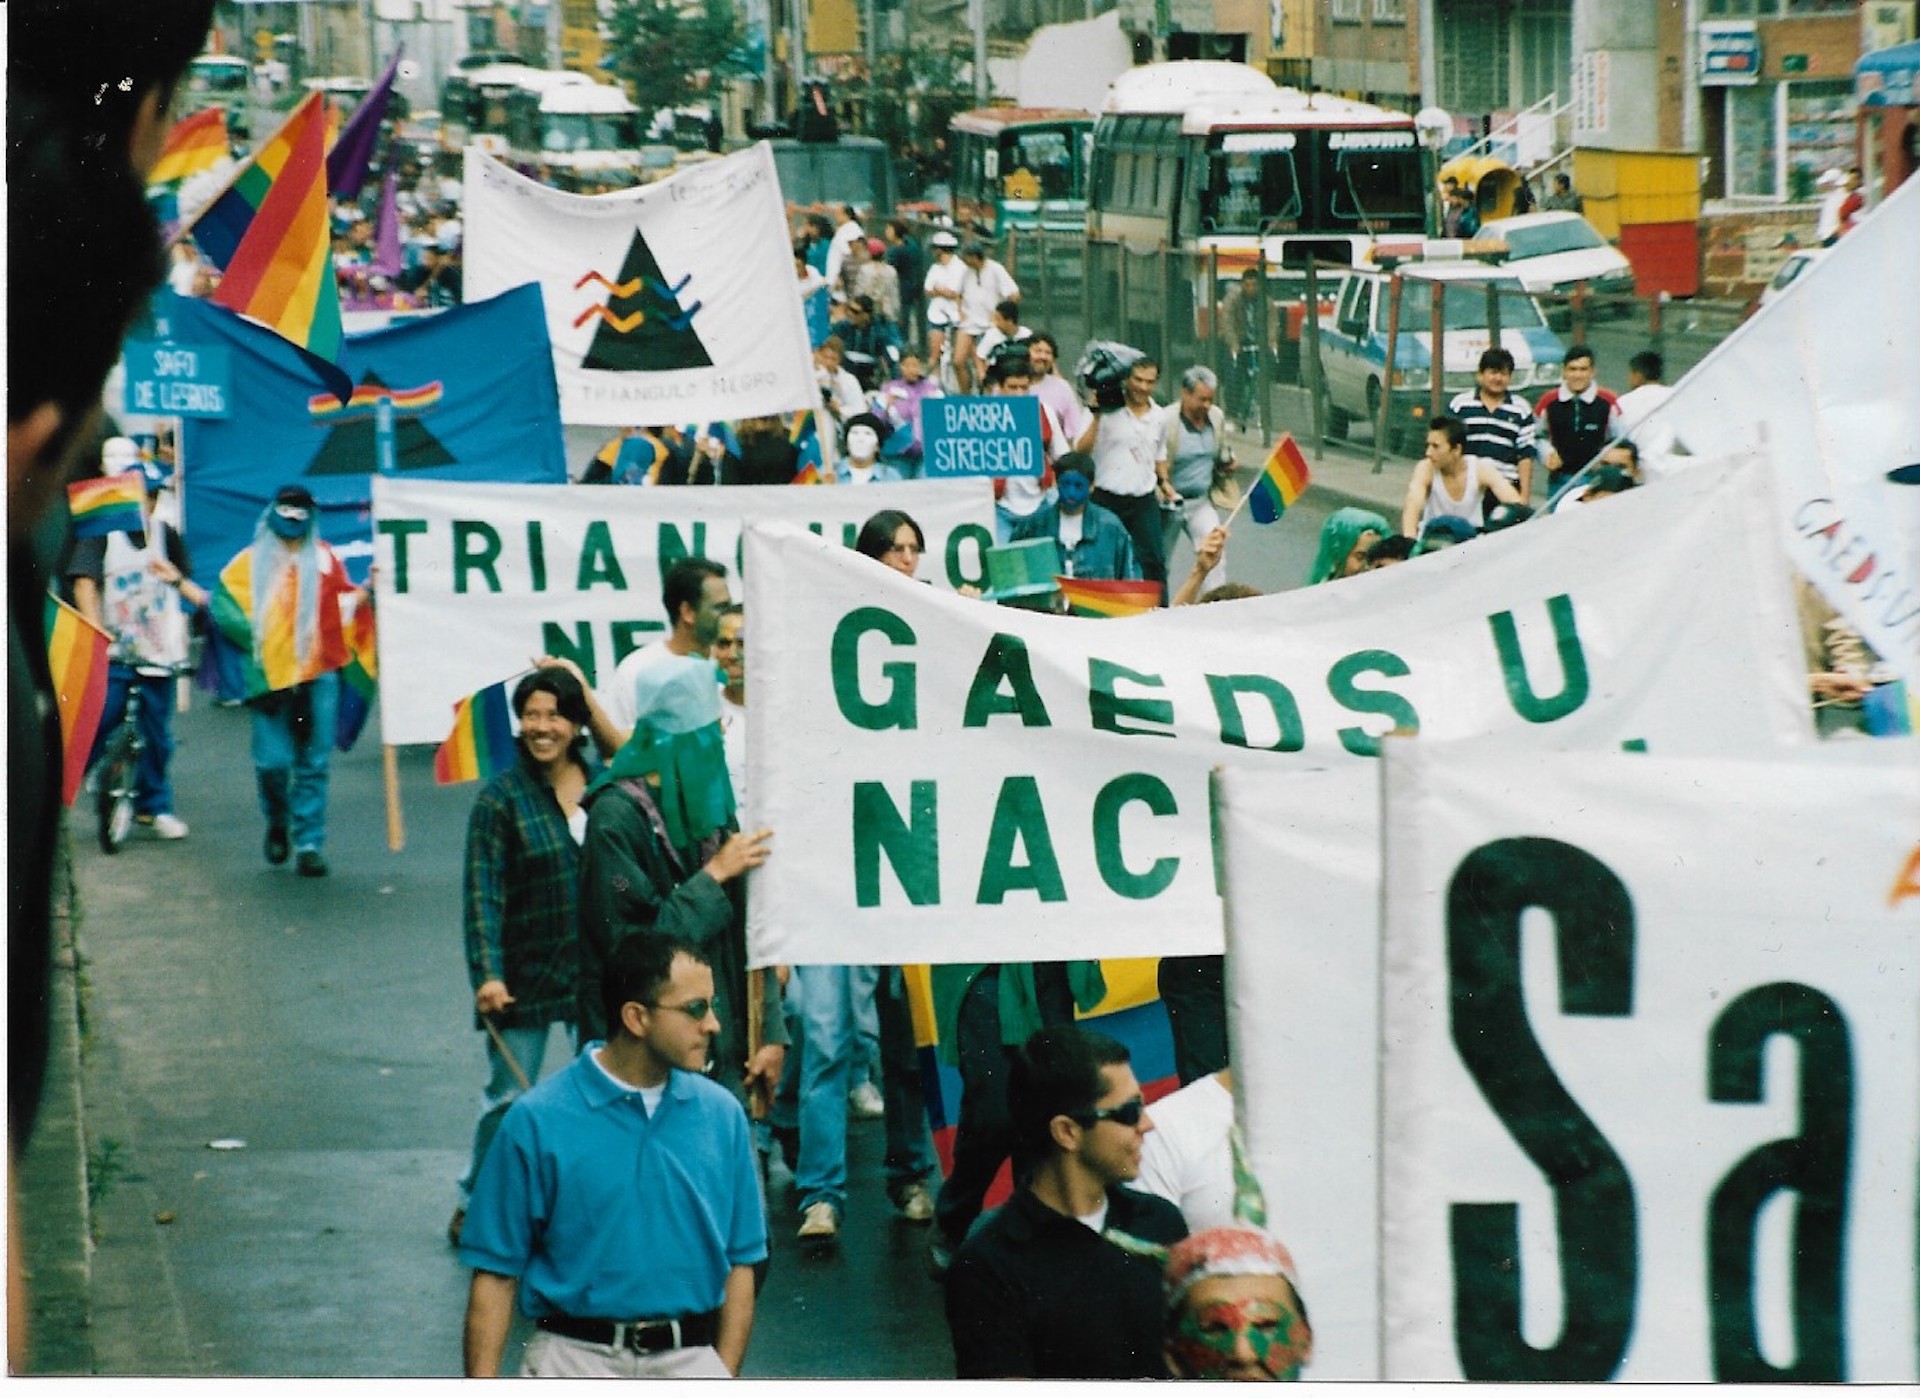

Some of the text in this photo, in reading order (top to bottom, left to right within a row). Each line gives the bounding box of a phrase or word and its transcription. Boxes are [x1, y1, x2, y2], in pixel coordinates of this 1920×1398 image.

[153, 350, 199, 379] SAFO
[134, 380, 225, 413] DE LESBOS
[944, 403, 1017, 433] BARBRA
[378, 519, 995, 595] TRIANO
[853, 766, 1224, 907] NAC
[1444, 835, 1920, 1382] Sa
